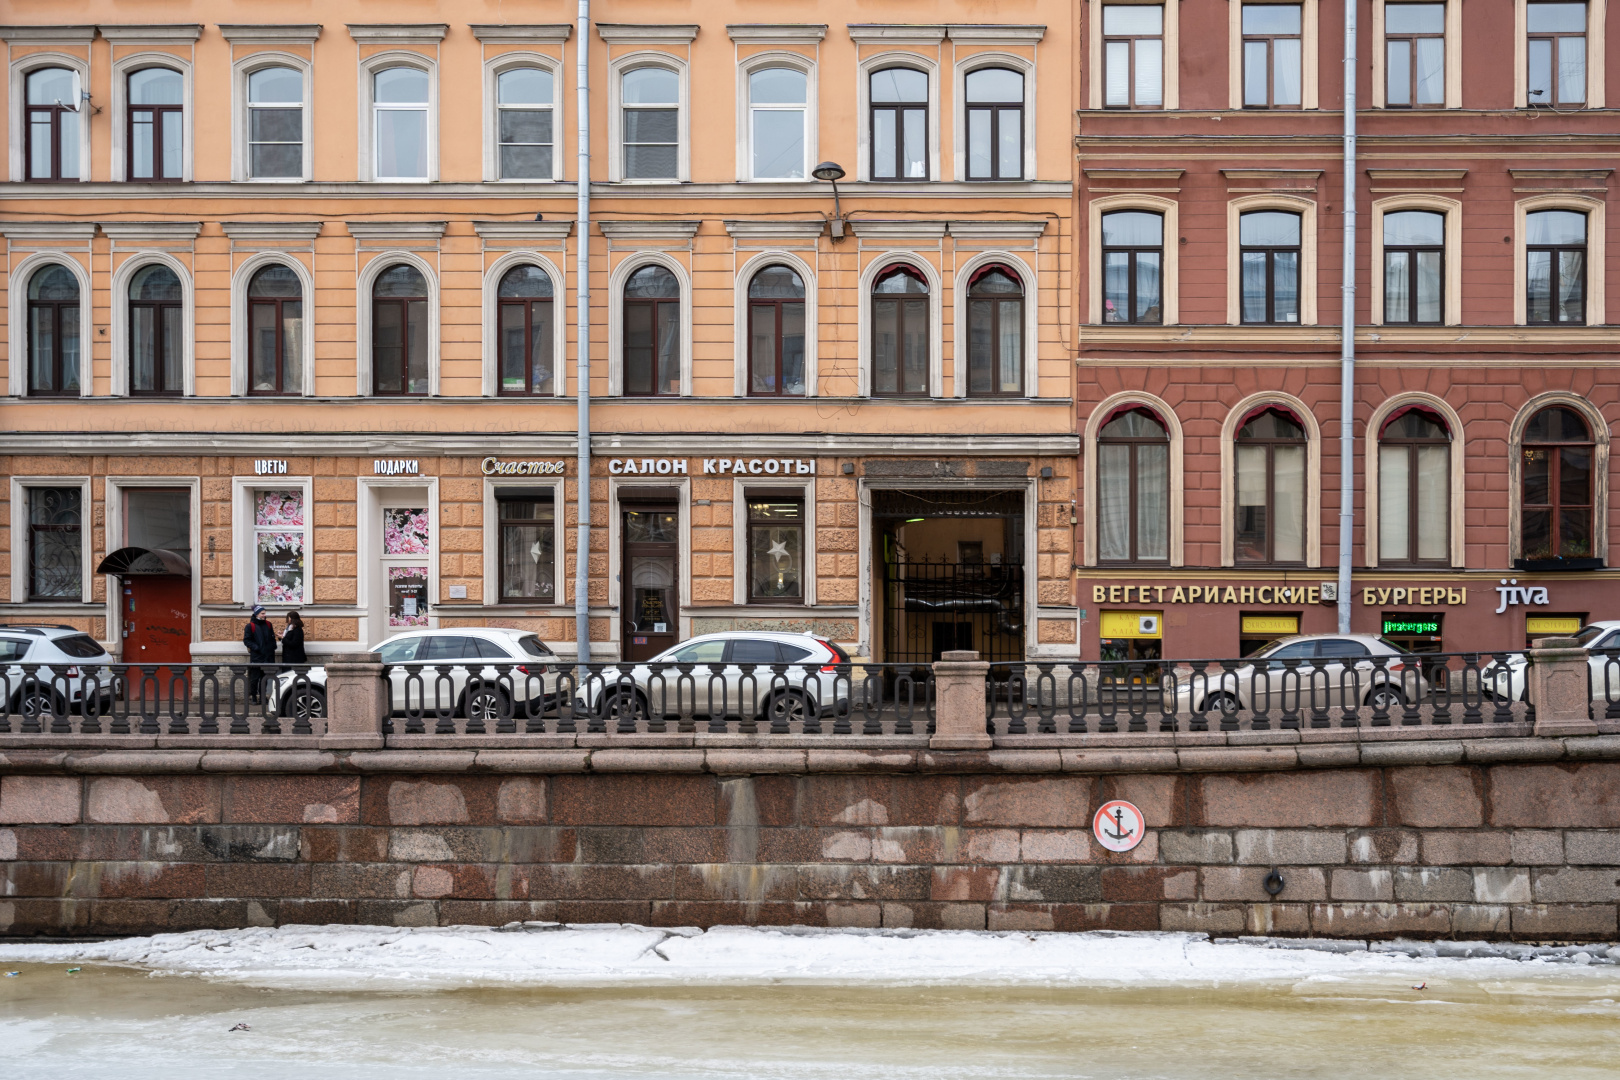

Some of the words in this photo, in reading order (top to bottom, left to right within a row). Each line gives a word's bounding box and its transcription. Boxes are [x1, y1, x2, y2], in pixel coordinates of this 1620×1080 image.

[254, 460, 287, 475] ЦВЕТЫ
[374, 460, 418, 475] ПОДАРКИ
[481, 457, 565, 475] Счастье
[608, 459, 688, 474] САЛОН
[703, 459, 816, 474] КРАСОТЫ
[1093, 585, 1320, 604] ВЕГЕТАРИАНСКИЕ
[1363, 587, 1467, 605] БУРГЕРЫ
[1495, 578, 1550, 614] jiva
